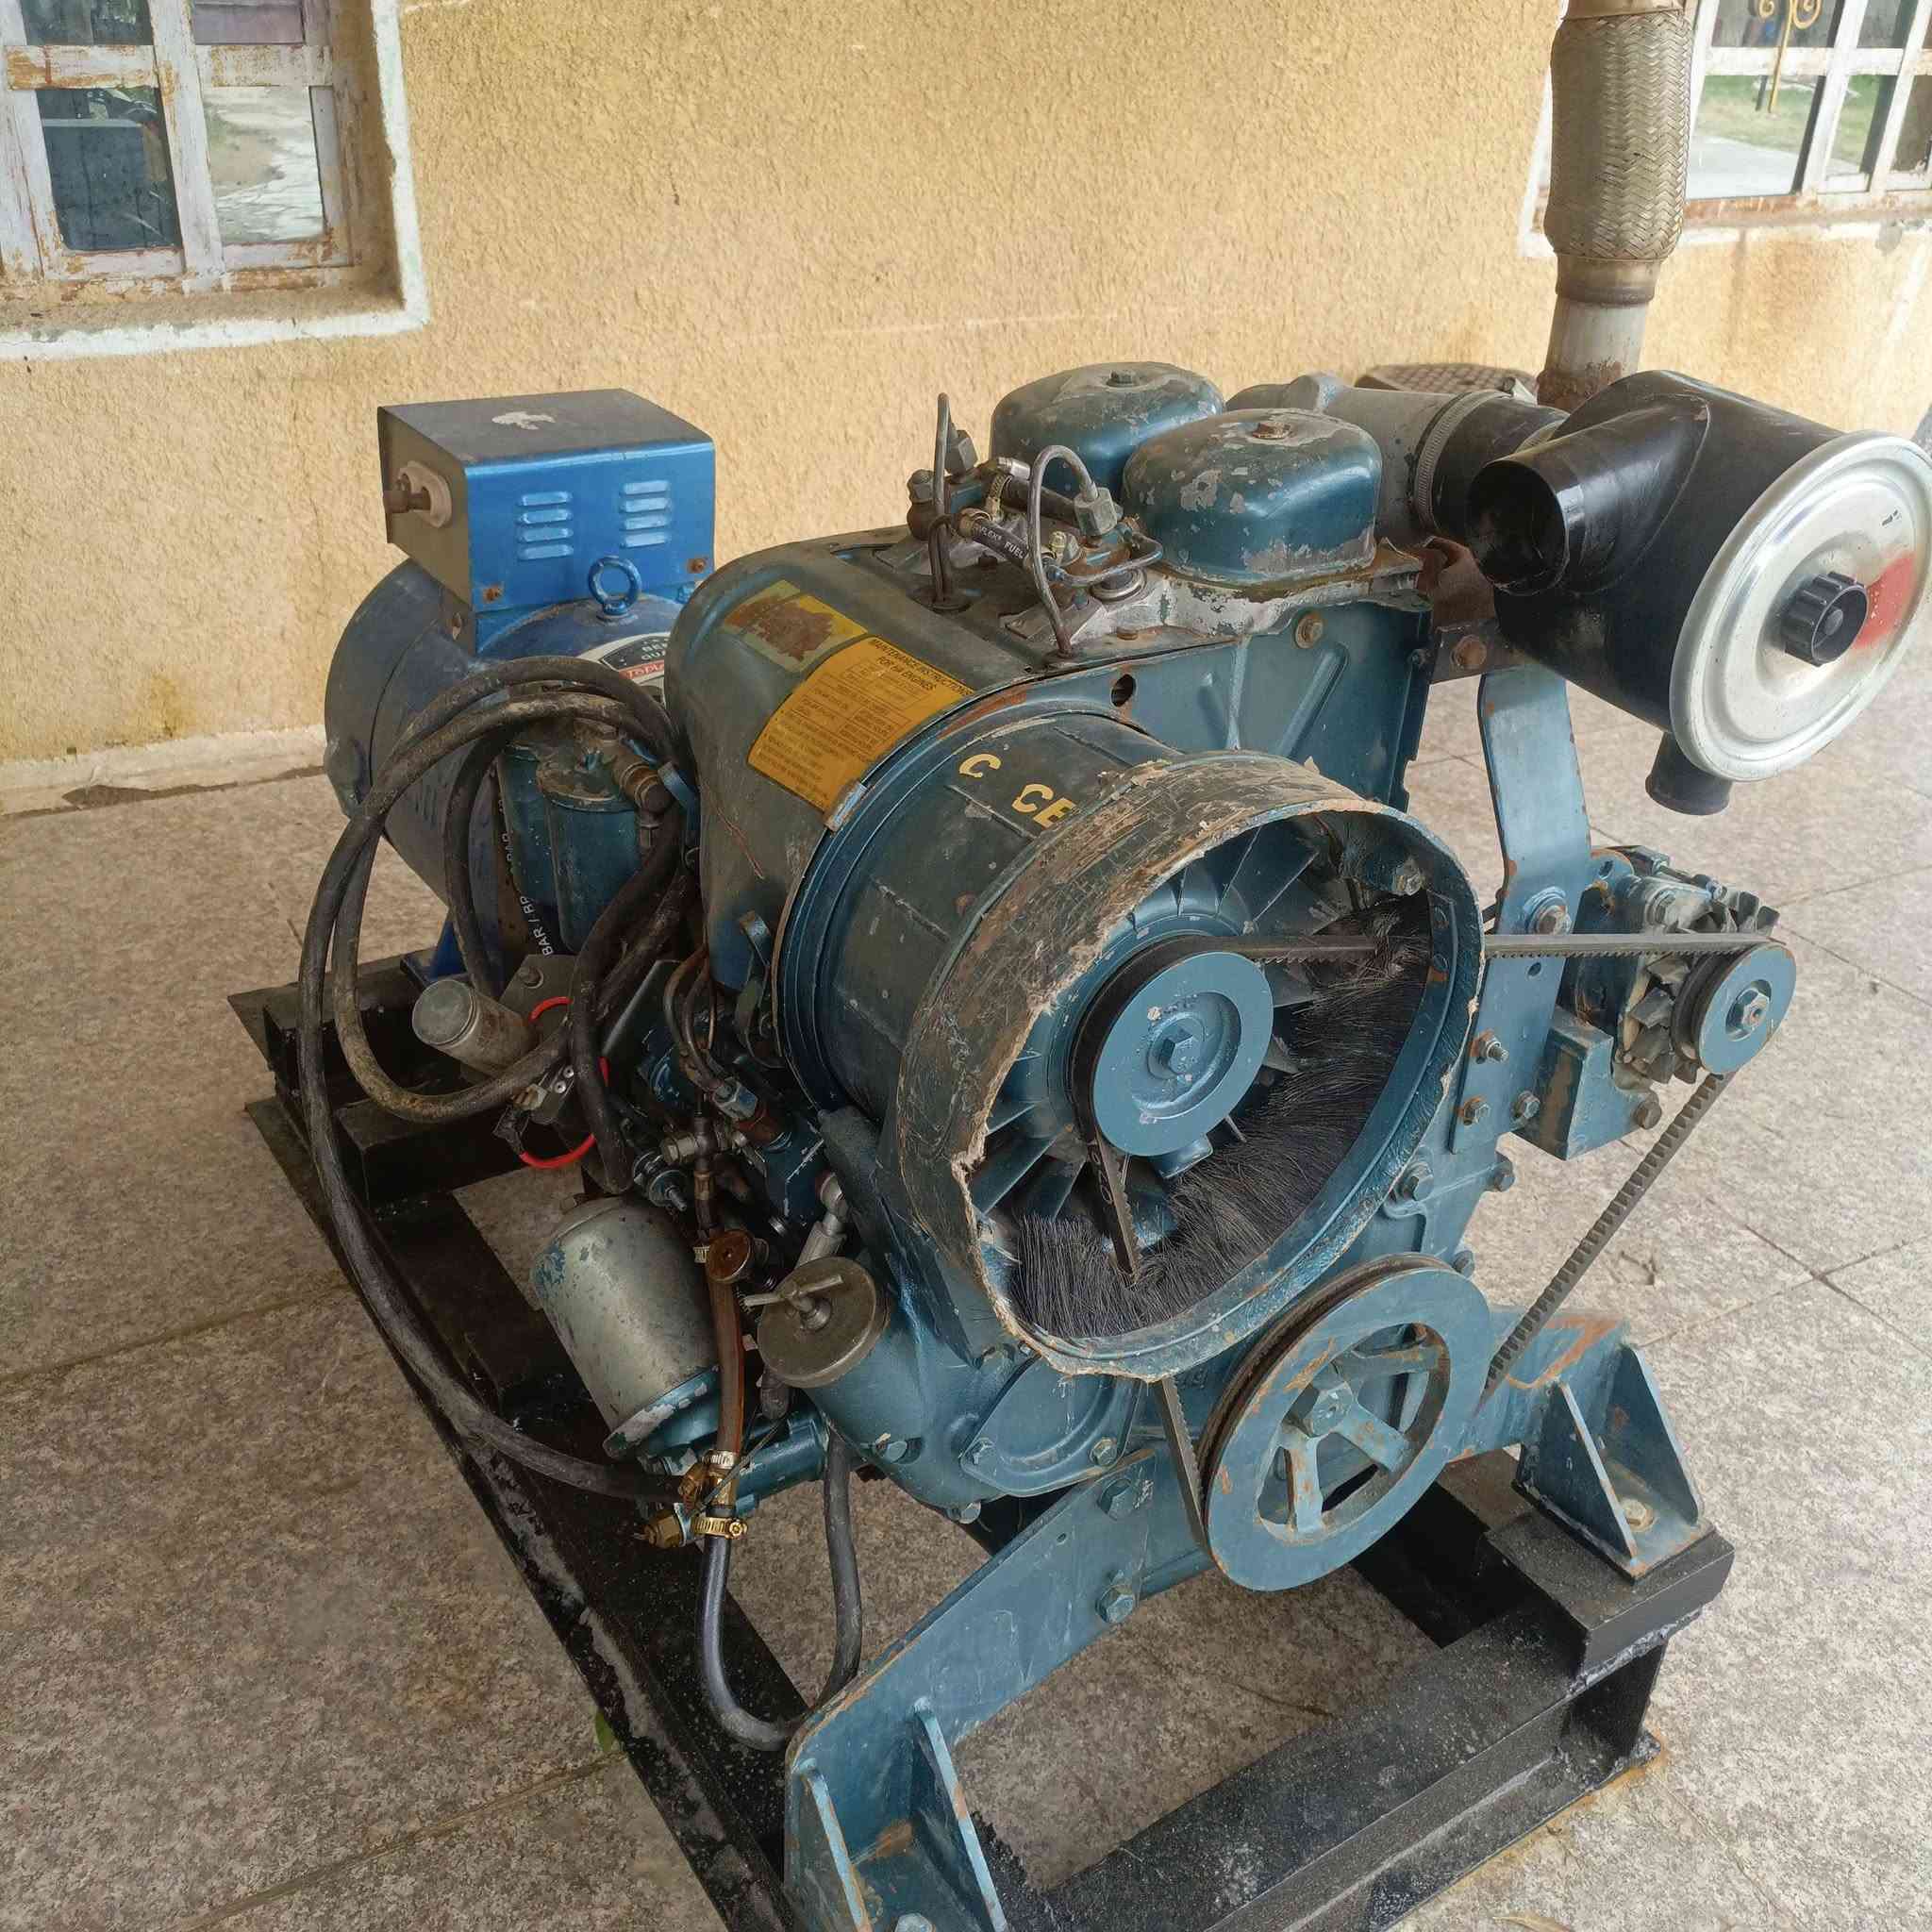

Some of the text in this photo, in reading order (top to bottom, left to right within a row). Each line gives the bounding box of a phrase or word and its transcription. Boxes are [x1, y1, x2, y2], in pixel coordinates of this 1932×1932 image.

[1004, 541, 1024, 559] FUEL
[959, 754, 1002, 778] C
[533, 924, 555, 957] BAR
